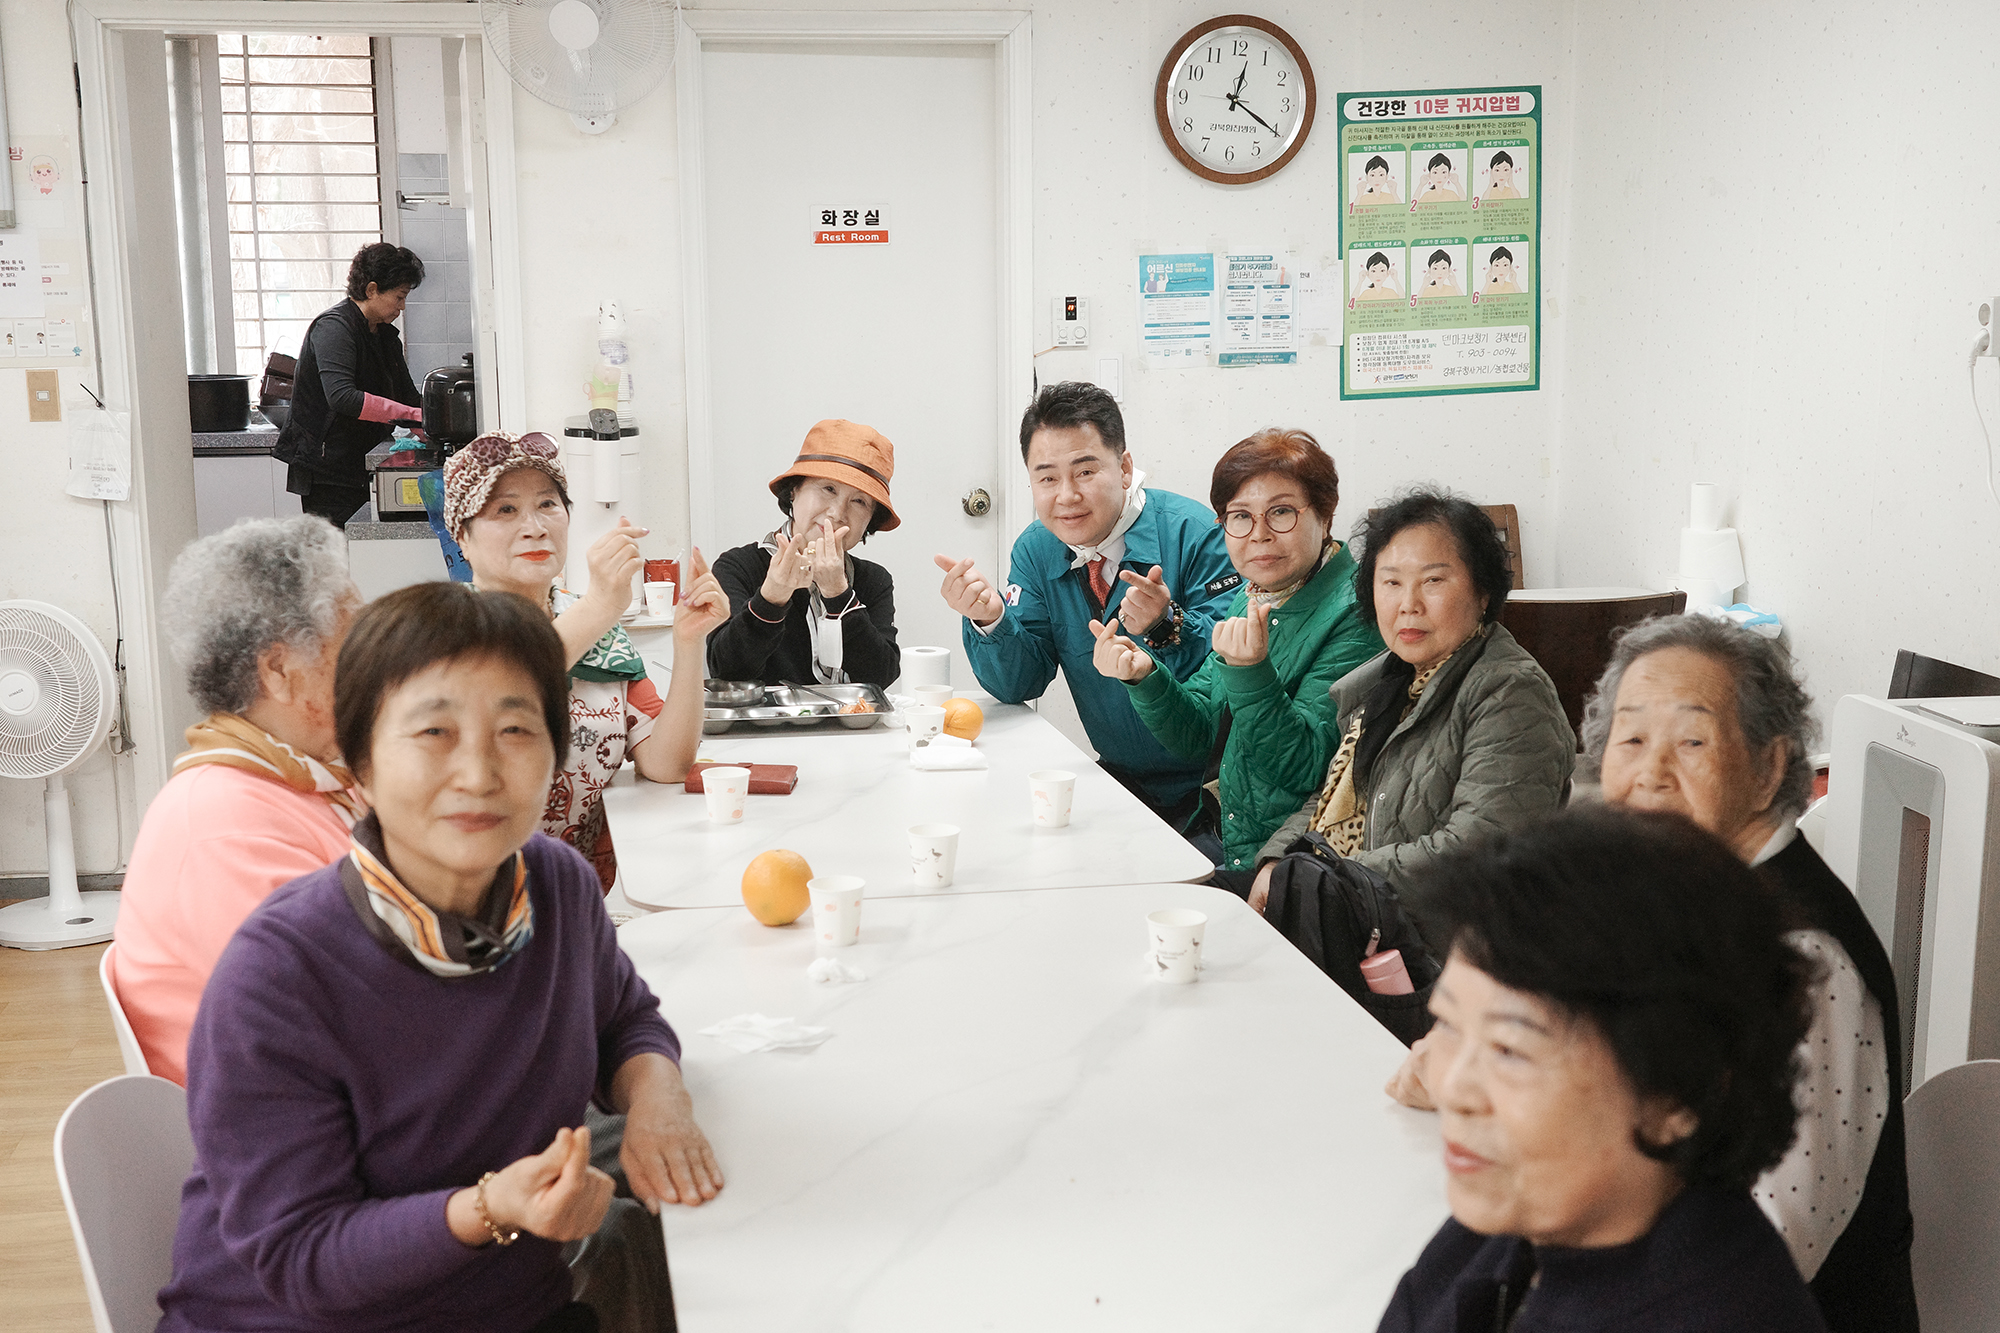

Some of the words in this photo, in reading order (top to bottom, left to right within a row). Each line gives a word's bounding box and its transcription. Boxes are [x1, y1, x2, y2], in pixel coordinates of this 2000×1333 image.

[1206, 47, 1222, 64] 11
[1232, 40, 1248, 56] 12
[1262, 50, 1268, 66] 1
[1188, 65, 1204, 81] 10
[1277, 70, 1287, 86] 2
[1178, 88, 1188, 104] 9
[1280, 97, 1290, 113] 3
[1358, 100, 1406, 116] 건강한
[1414, 98, 1450, 114] 10분
[1456, 96, 1520, 113] 귀지압법
[1182, 117, 1193, 132] 8
[1270, 122, 1280, 138] 4
[1201, 136, 1210, 152] 7
[1251, 141, 1261, 156] 5
[1224, 146, 1234, 162] 6
[1349, 202, 1354, 214] 1
[1410, 199, 1418, 212] 2
[1472, 196, 1480, 209] 3
[822, 210, 880, 226] 화장실
[822, 234, 846, 242] Rest
[851, 233, 880, 241] Room
[1147, 264, 1173, 273] 어르신
[1348, 298, 1356, 310] 4
[1410, 294, 1418, 307] 5
[1472, 292, 1480, 304] 6
[1896, 731, 1904, 741] SK
